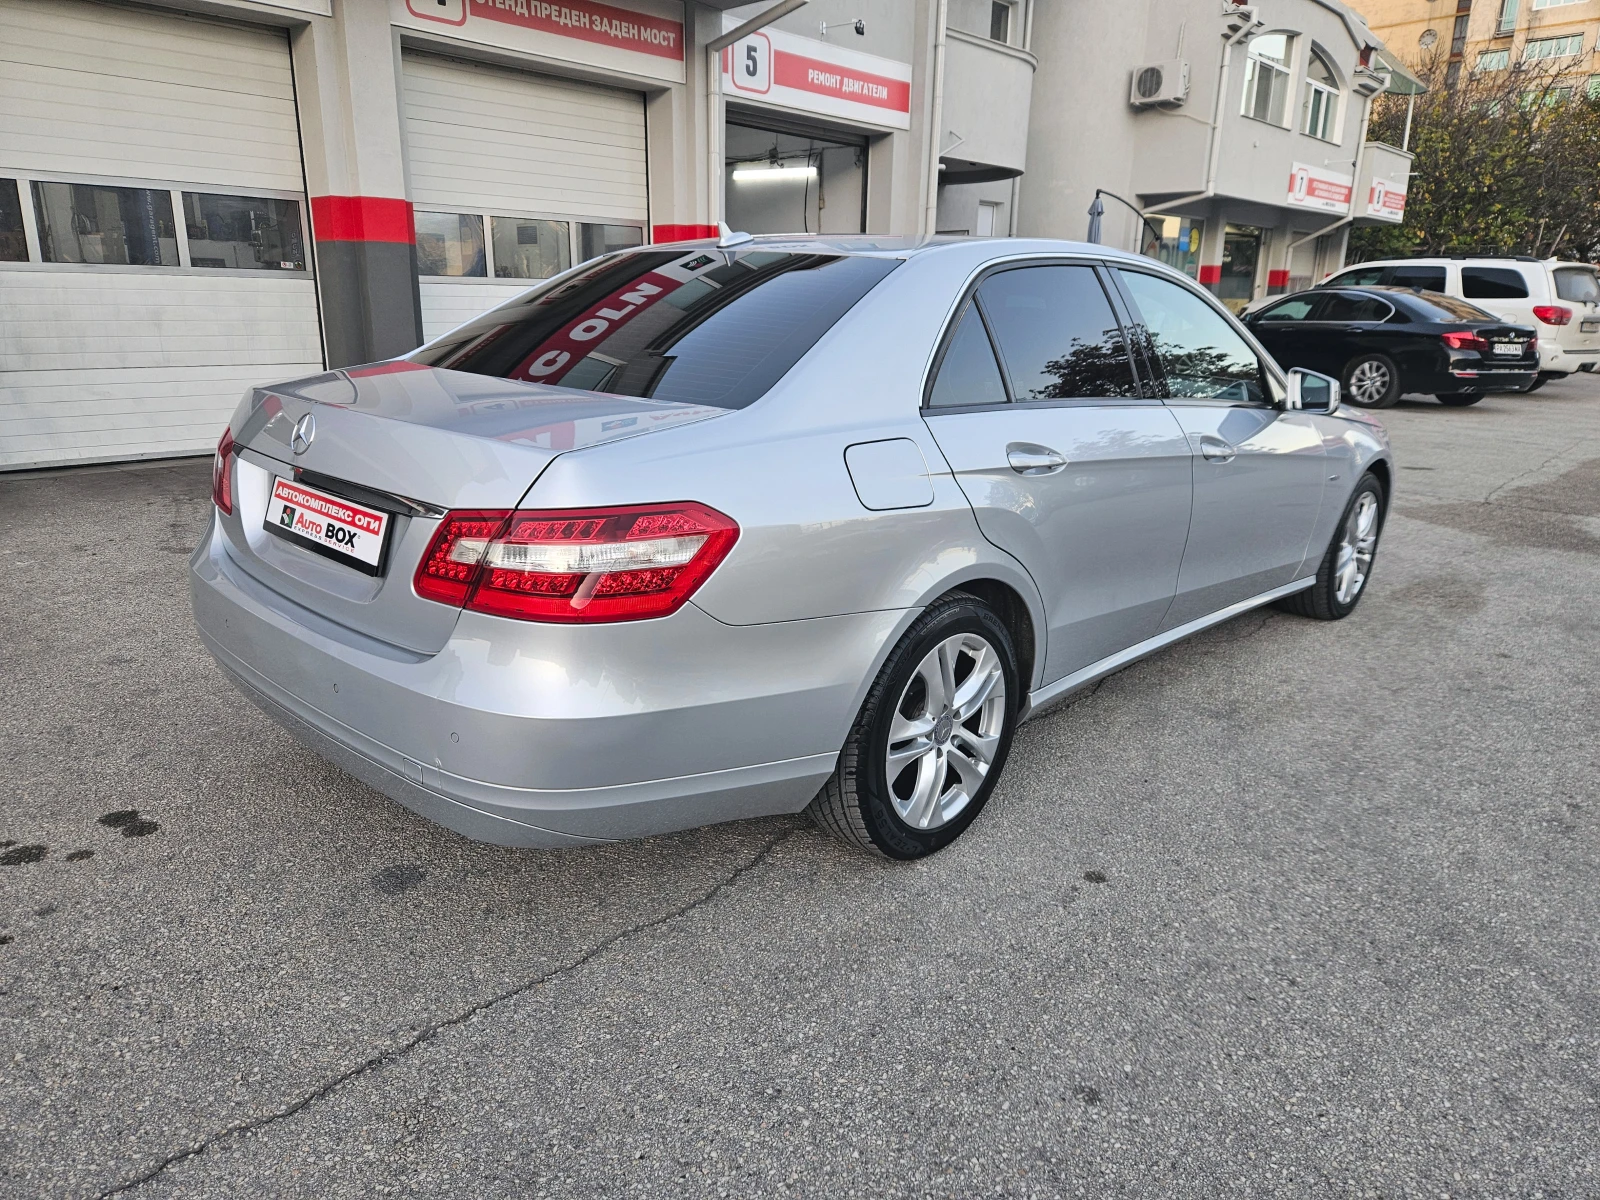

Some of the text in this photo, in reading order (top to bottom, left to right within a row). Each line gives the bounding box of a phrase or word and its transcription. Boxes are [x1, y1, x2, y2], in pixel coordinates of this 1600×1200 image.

[475, 0, 676, 47] ЕНД ПРЕДЕН ЗАДЕН МОСТ
[745, 44, 758, 77] 5
[808, 68, 888, 100] РЕМОНТ ДВИГАТЕЛИ
[275, 485, 380, 532] АВТОКОМПЛЕКС ОГИ
[294, 525, 355, 553] EXPRESS SERVICE
[325, 522, 357, 548] BOX
